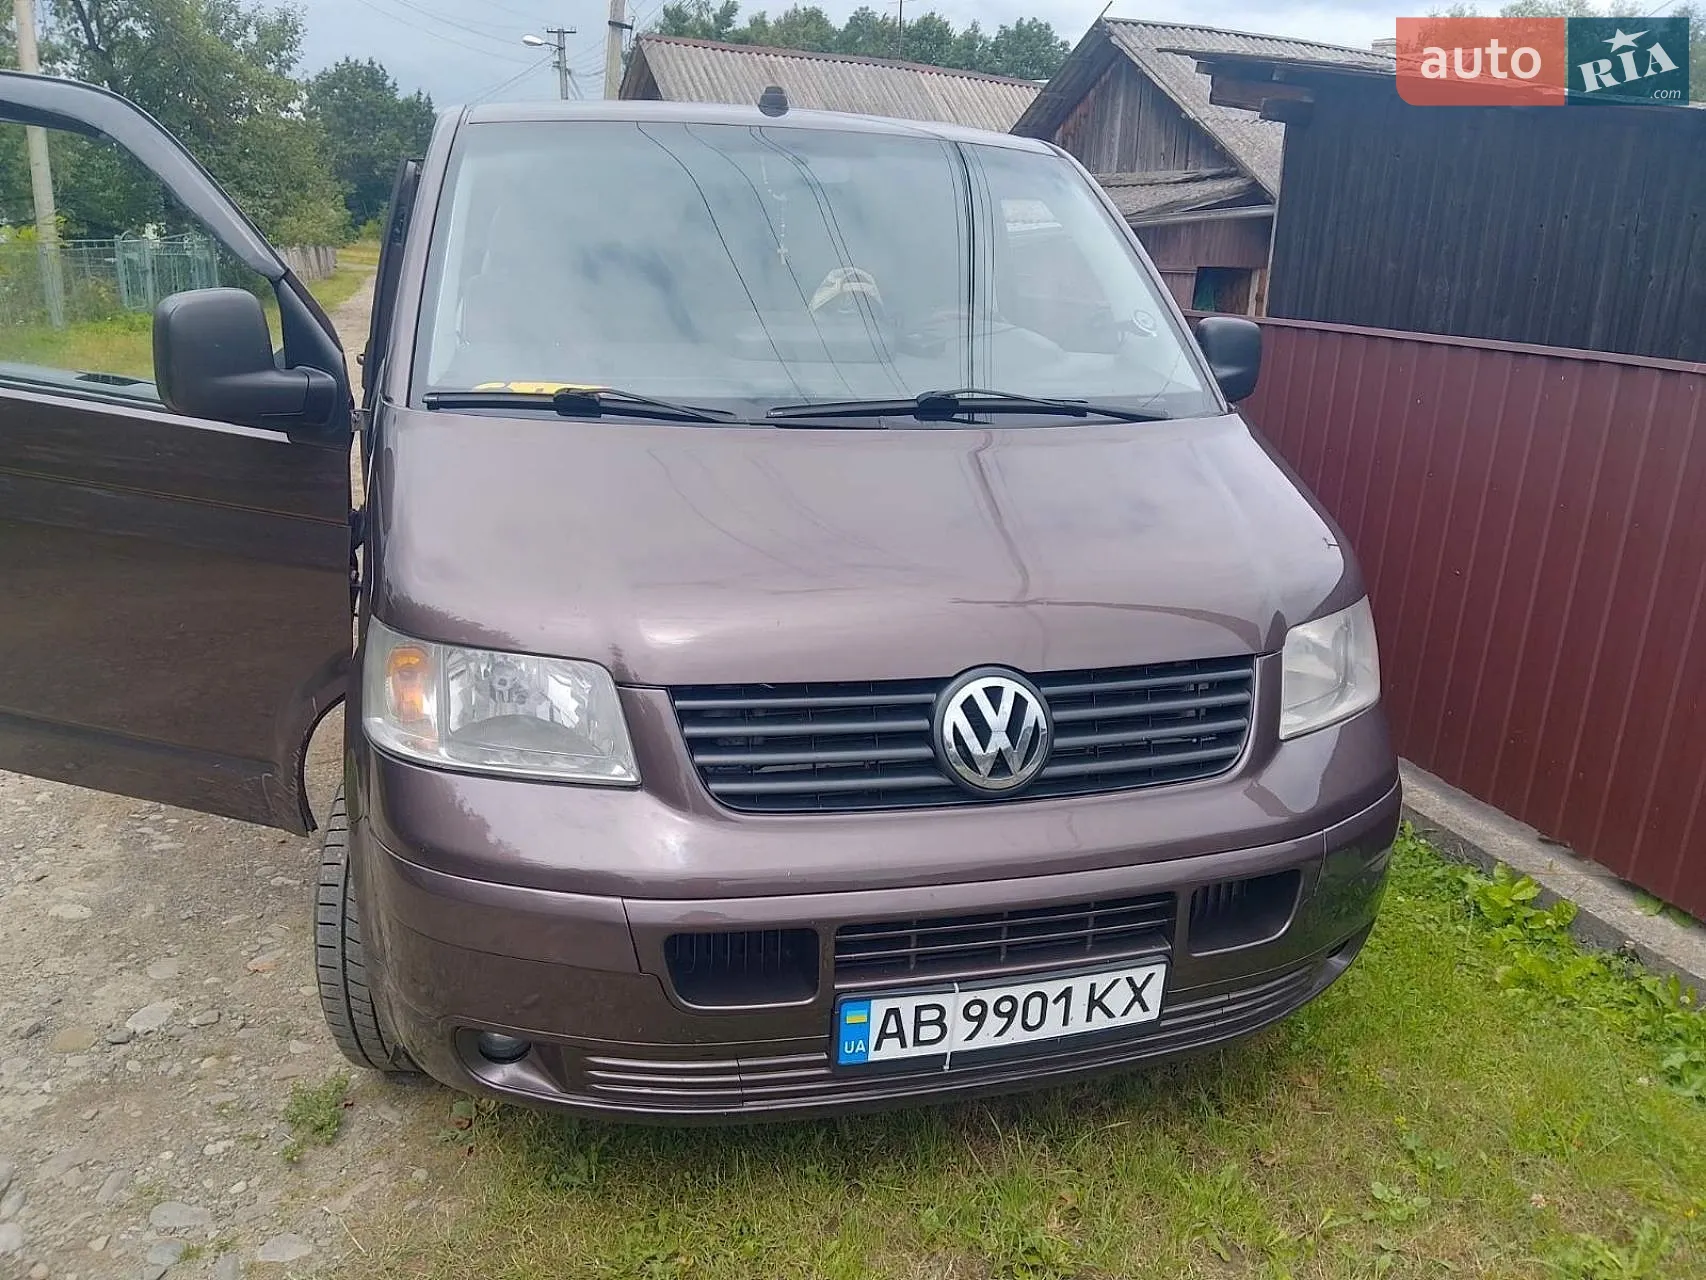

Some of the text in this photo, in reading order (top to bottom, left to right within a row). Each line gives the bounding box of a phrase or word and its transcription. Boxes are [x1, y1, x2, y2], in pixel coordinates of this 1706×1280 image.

[943, 676, 1048, 790] VW
[844, 1039, 866, 1054] UA
[873, 972, 1156, 1051] AB 9901 KX
